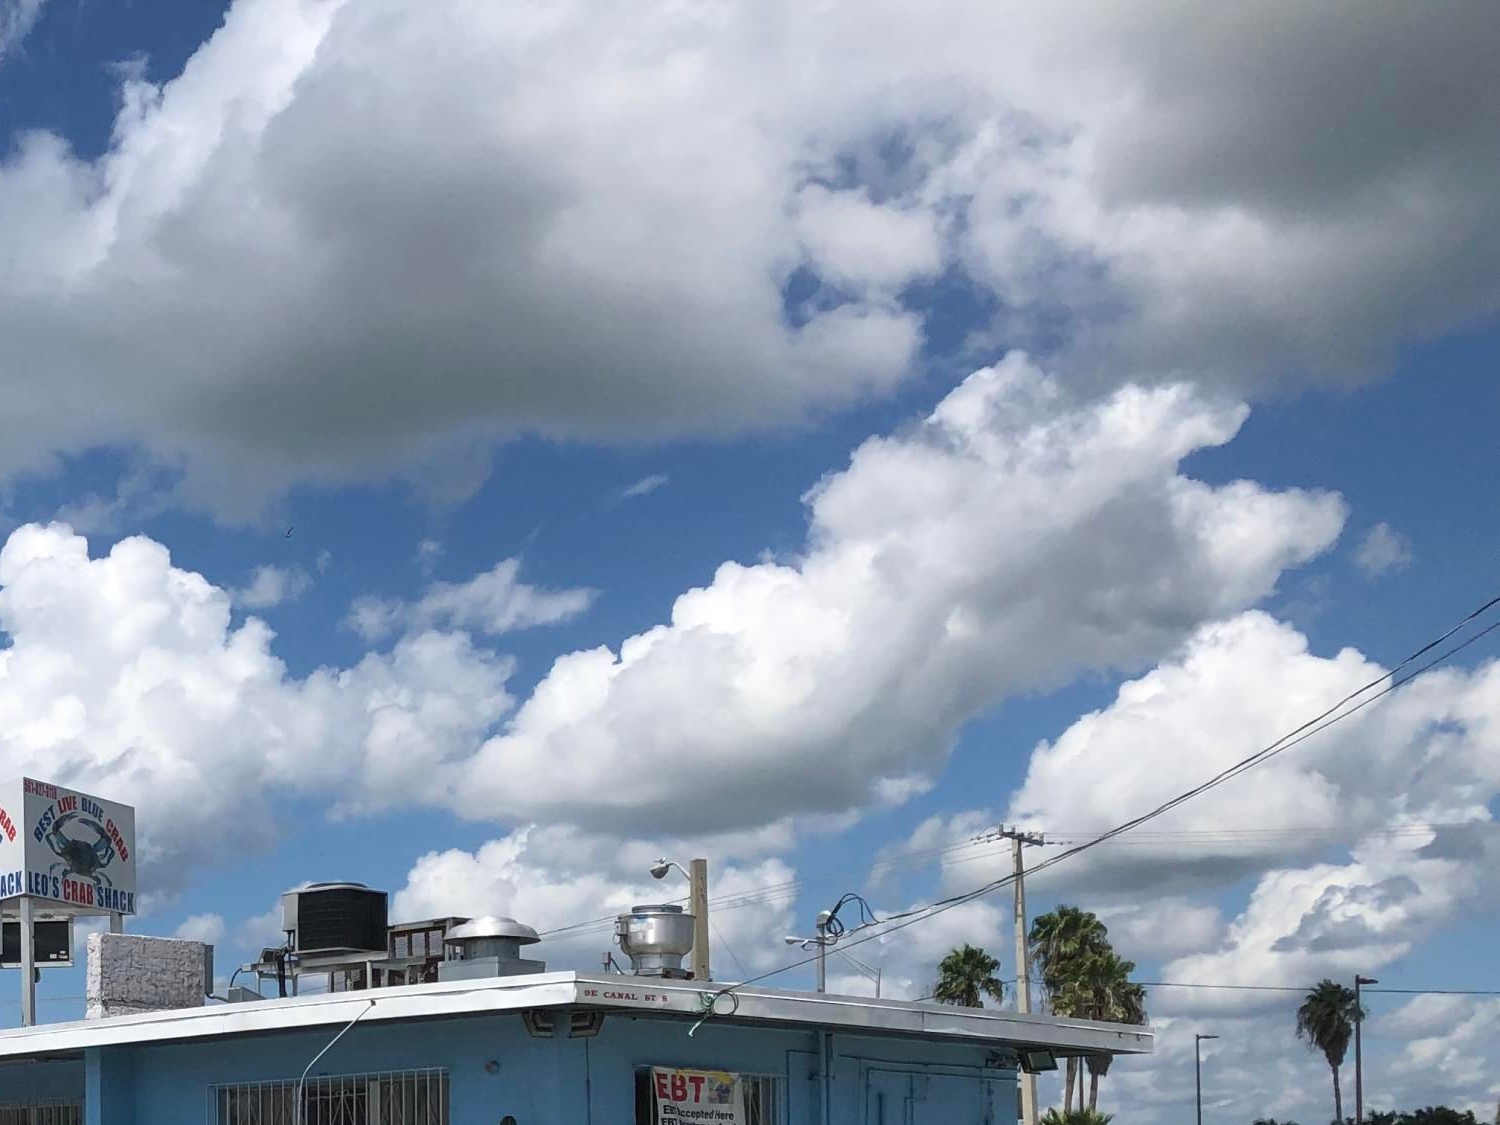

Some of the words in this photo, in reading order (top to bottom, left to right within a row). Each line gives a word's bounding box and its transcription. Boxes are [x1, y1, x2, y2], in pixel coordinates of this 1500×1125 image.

[33, 805, 56, 842] BEST
[57, 796, 77, 814] LIVE
[81, 797, 104, 822] BLUE
[105, 818, 129, 862] CRAB
[28, 871, 59, 899] LEO'S
[63, 878, 94, 905] CRAB
[97, 886, 135, 913] SHACK
[604, 991, 638, 1001] CANAL
[656, 1073, 706, 1104] EBT
[715, 1111, 734, 1120] Here
